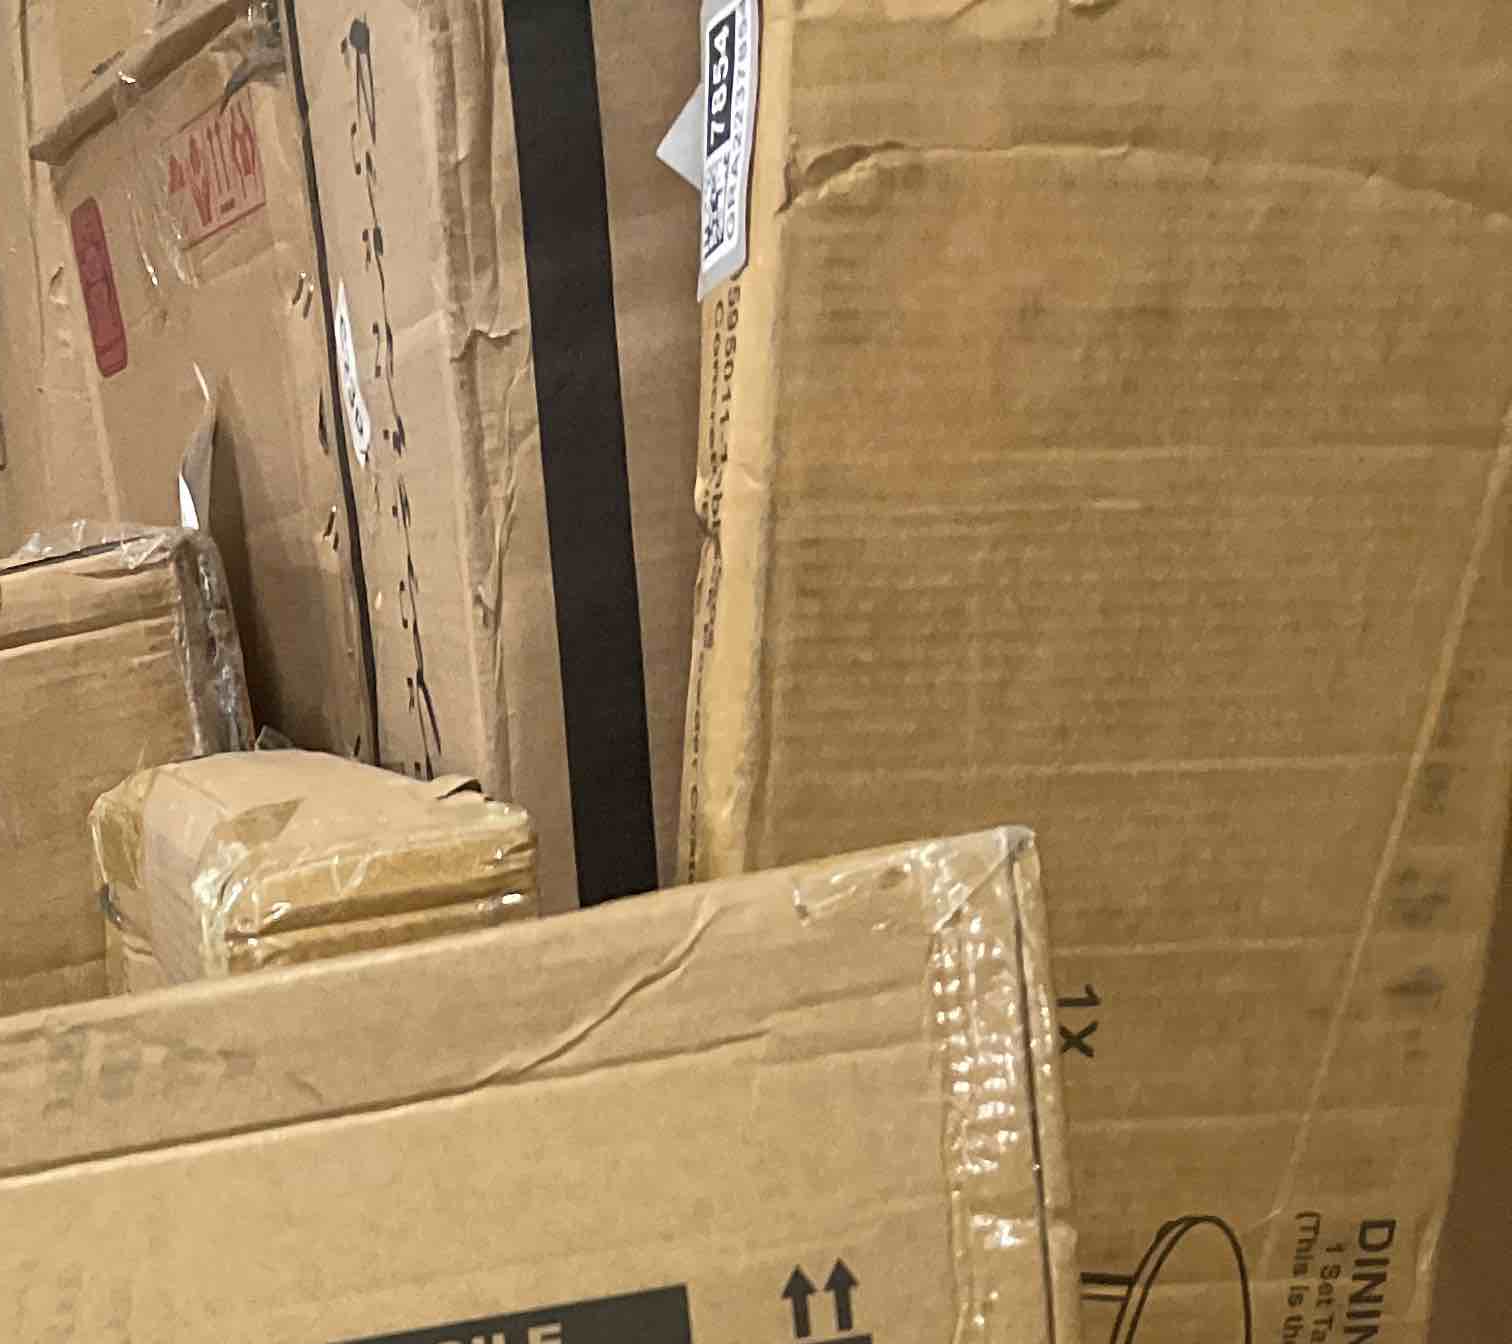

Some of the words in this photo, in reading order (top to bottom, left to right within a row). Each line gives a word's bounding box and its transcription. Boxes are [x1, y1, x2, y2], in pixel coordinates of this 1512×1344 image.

[711, 24, 730, 146] 7854
[1292, 1210, 1321, 1278] (This
[1287, 1285, 1310, 1307] is
[1315, 1264, 1341, 1308] Set
